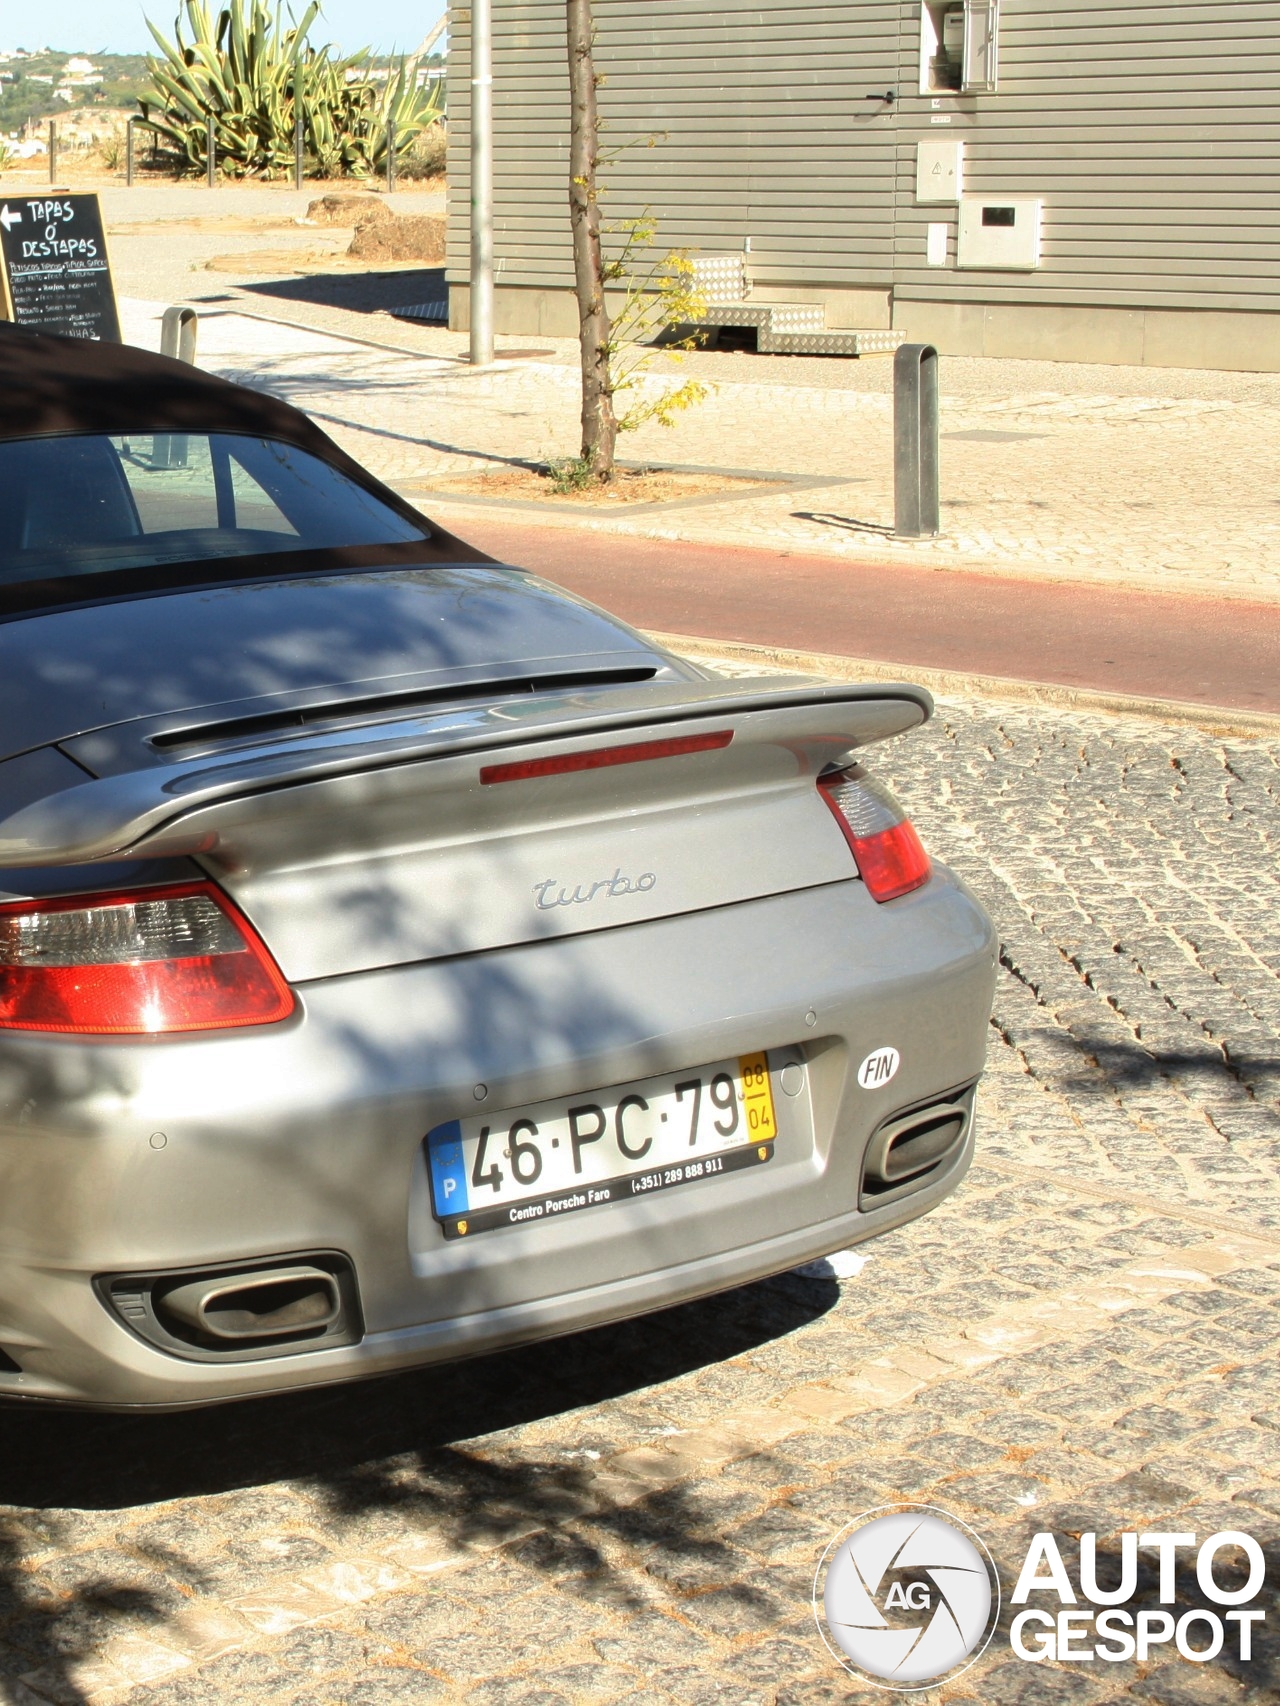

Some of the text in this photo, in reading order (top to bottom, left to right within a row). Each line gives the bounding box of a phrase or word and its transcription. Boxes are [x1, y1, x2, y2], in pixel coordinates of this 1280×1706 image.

[27, 200, 75, 223] TAPAS
[22, 238, 97, 258] DESTAPAS
[532, 868, 656, 909] turbo
[743, 1063, 765, 1089] 08
[864, 1053, 894, 1084] FIN
[748, 1106, 770, 1130] 04
[443, 1177, 457, 1199] P
[509, 1157, 724, 1222] Centro Porsche Faro (+351) 289 888 911
